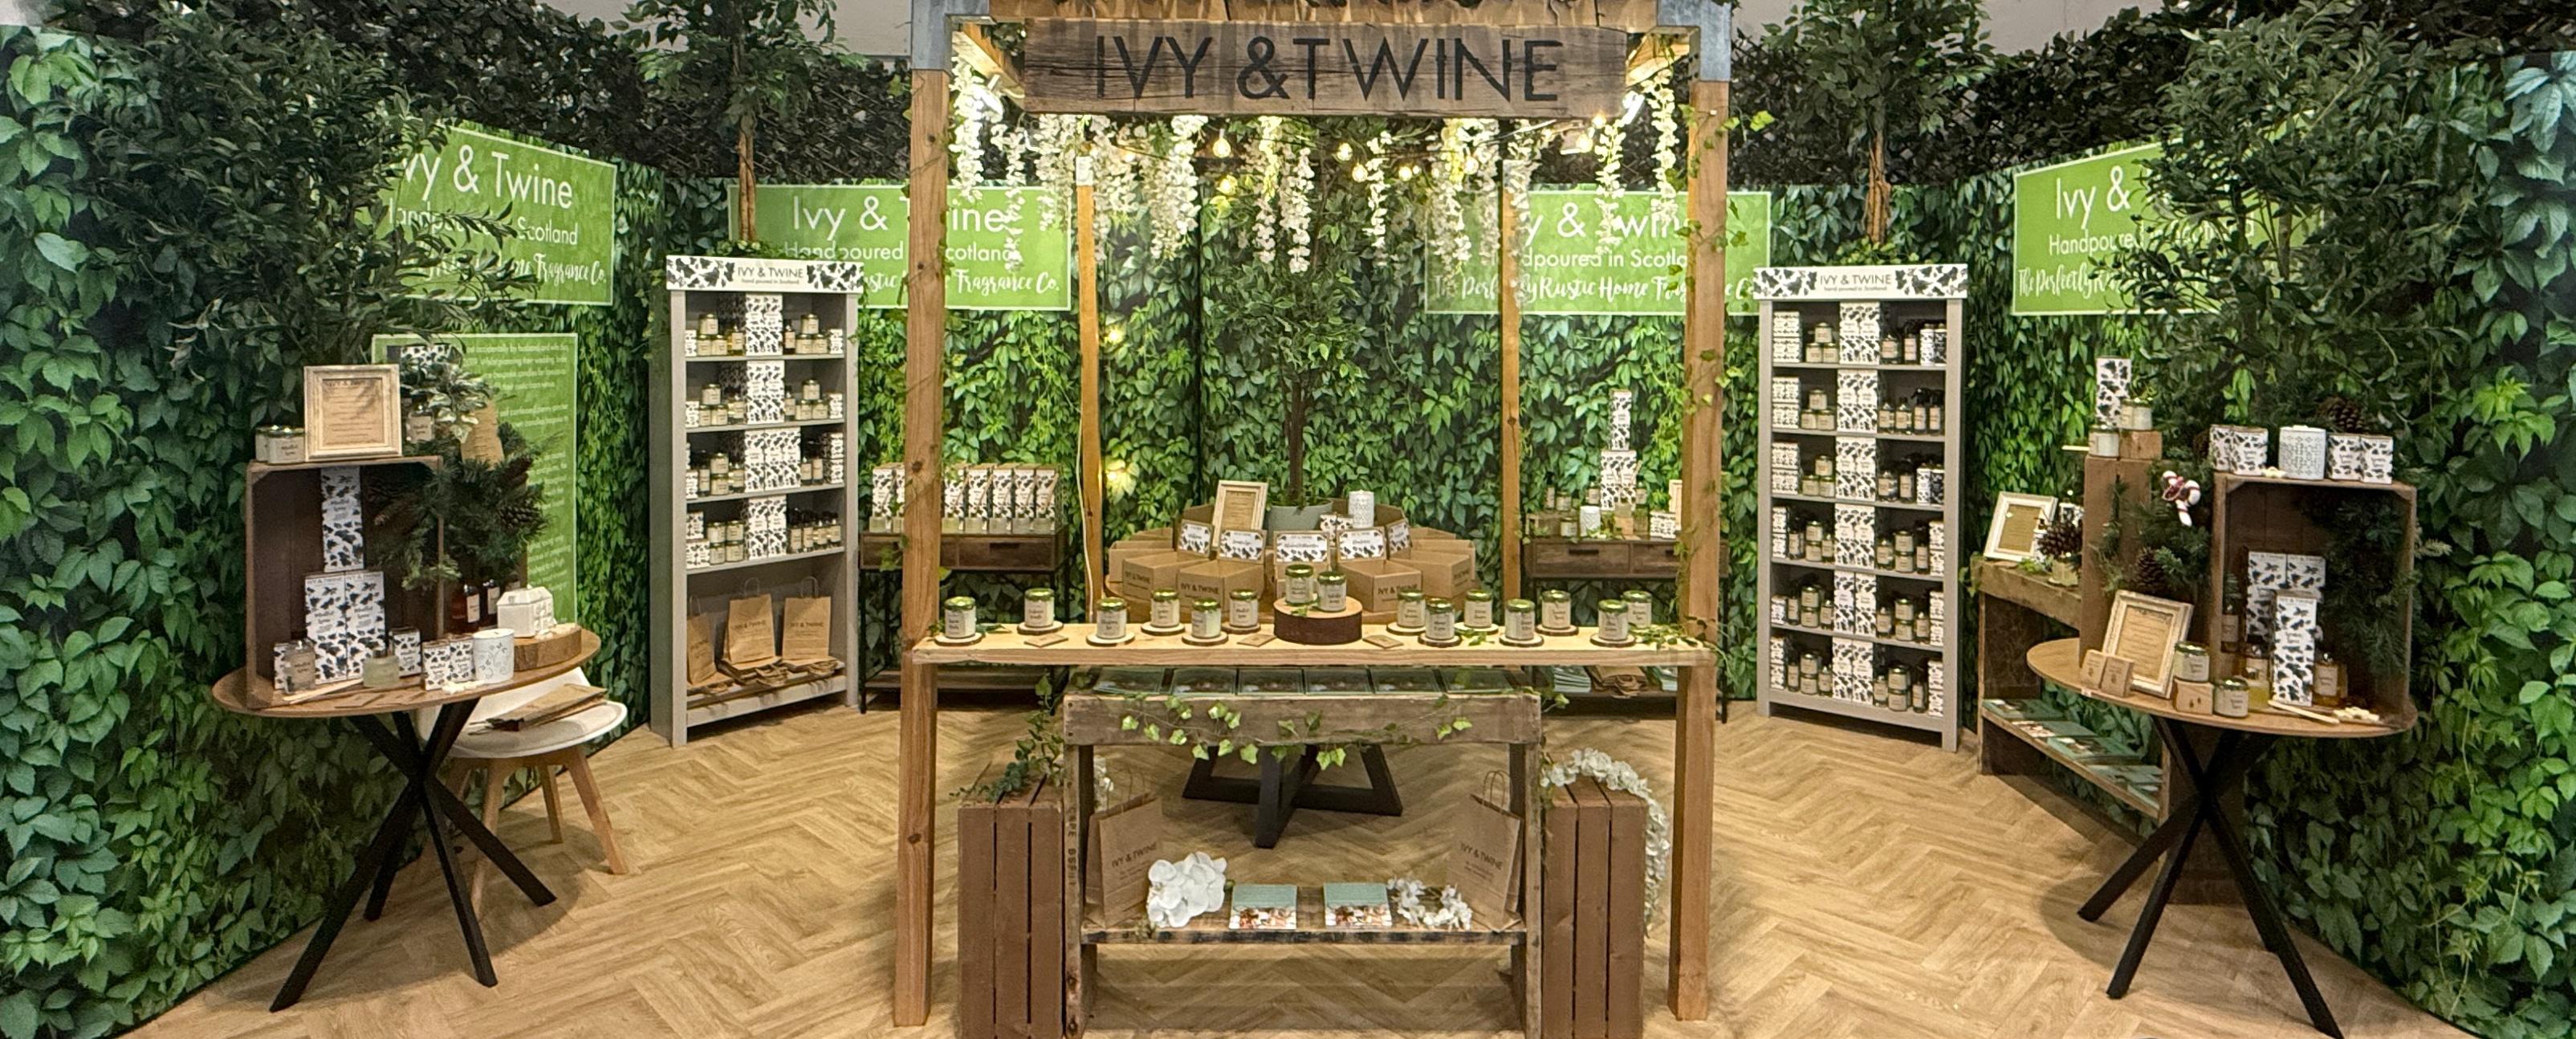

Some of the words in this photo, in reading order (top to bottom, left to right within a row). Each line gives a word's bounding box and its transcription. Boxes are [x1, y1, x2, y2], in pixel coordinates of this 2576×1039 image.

[1096, 35, 1213, 100] IVY
[402, 152, 441, 201] vy
[454, 145, 479, 194] &
[491, 151, 572, 209] Twine
[2056, 177, 2097, 229] Ivy
[2106, 165, 2131, 212] &
[517, 216, 579, 245] Scotland
[793, 195, 846, 241] Ivy
[860, 196, 889, 232] &
[1557, 202, 1586, 238] &
[945, 241, 1011, 262] cotlan
[1520, 247, 1602, 271] dpoured
[1608, 249, 1625, 267] in
[1630, 248, 1688, 267] Scotla
[533, 253, 589, 286] Fragrance
[591, 260, 607, 286] Co.
[738, 267, 755, 277] IVY
[757, 267, 766, 278] &
[768, 267, 804, 278] TWINE
[954, 269, 1032, 296] Fragrance
[1036, 271, 1060, 294] Co.
[1820, 274, 1837, 285] IVY
[1840, 275, 1849, 285] &
[1852, 274, 1892, 284] TWINE
[2036, 262, 2092, 299] Perfectly
[1540, 275, 1596, 301] Rustic
[1598, 275, 1648, 303] Home
